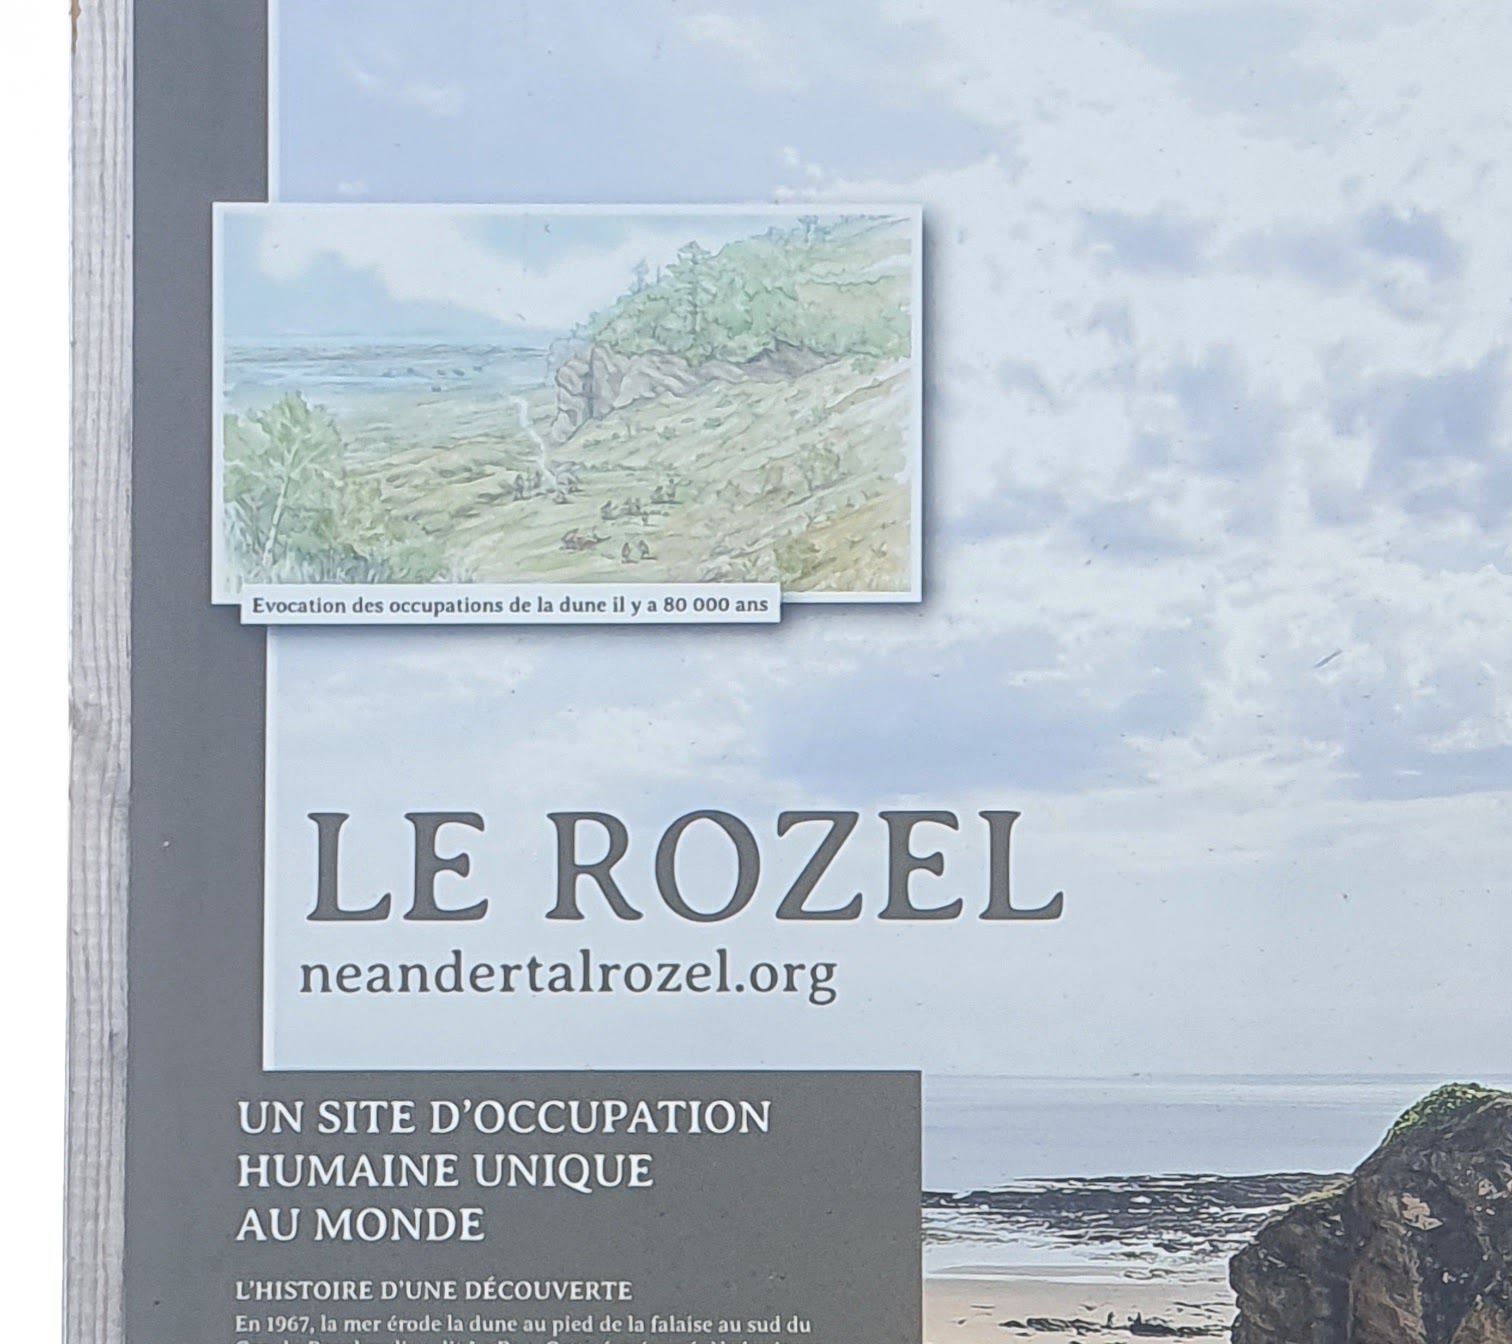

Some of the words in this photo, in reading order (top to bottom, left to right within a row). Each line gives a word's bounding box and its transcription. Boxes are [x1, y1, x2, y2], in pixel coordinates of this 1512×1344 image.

[252, 597, 346, 613] Evocation
[352, 596, 383, 613] des
[389, 596, 503, 617] occupations
[509, 595, 531, 612] de
[537, 595, 553, 612] la
[559, 595, 606, 612] dune
[613, 595, 624, 612] il
[631, 600, 641, 616] y
[647, 600, 657, 612] a
[663, 596, 687, 612] 80
[693, 597, 729, 612] 000
[735, 599, 768, 611] ans
[306, 811, 488, 921] LE
[544, 809, 1063, 922] ROZEL
[299, 948, 837, 1005] neandertalrozel.org
[238, 1101, 303, 1133] UN
[318, 1100, 415, 1133] SITE
[430, 1099, 771, 1133] D'OCCUPATION
[238, 1154, 458, 1187] HUMAINE
[473, 1153, 653, 1193] UNIQUE
[236, 1208, 300, 1240] AU
[314, 1207, 484, 1241] MONDE
[236, 1279, 373, 1300] L'HISTOIRE
[381, 1279, 456, 1300] D'UNE
[465, 1275, 632, 1301] DÉCOUVERTE
